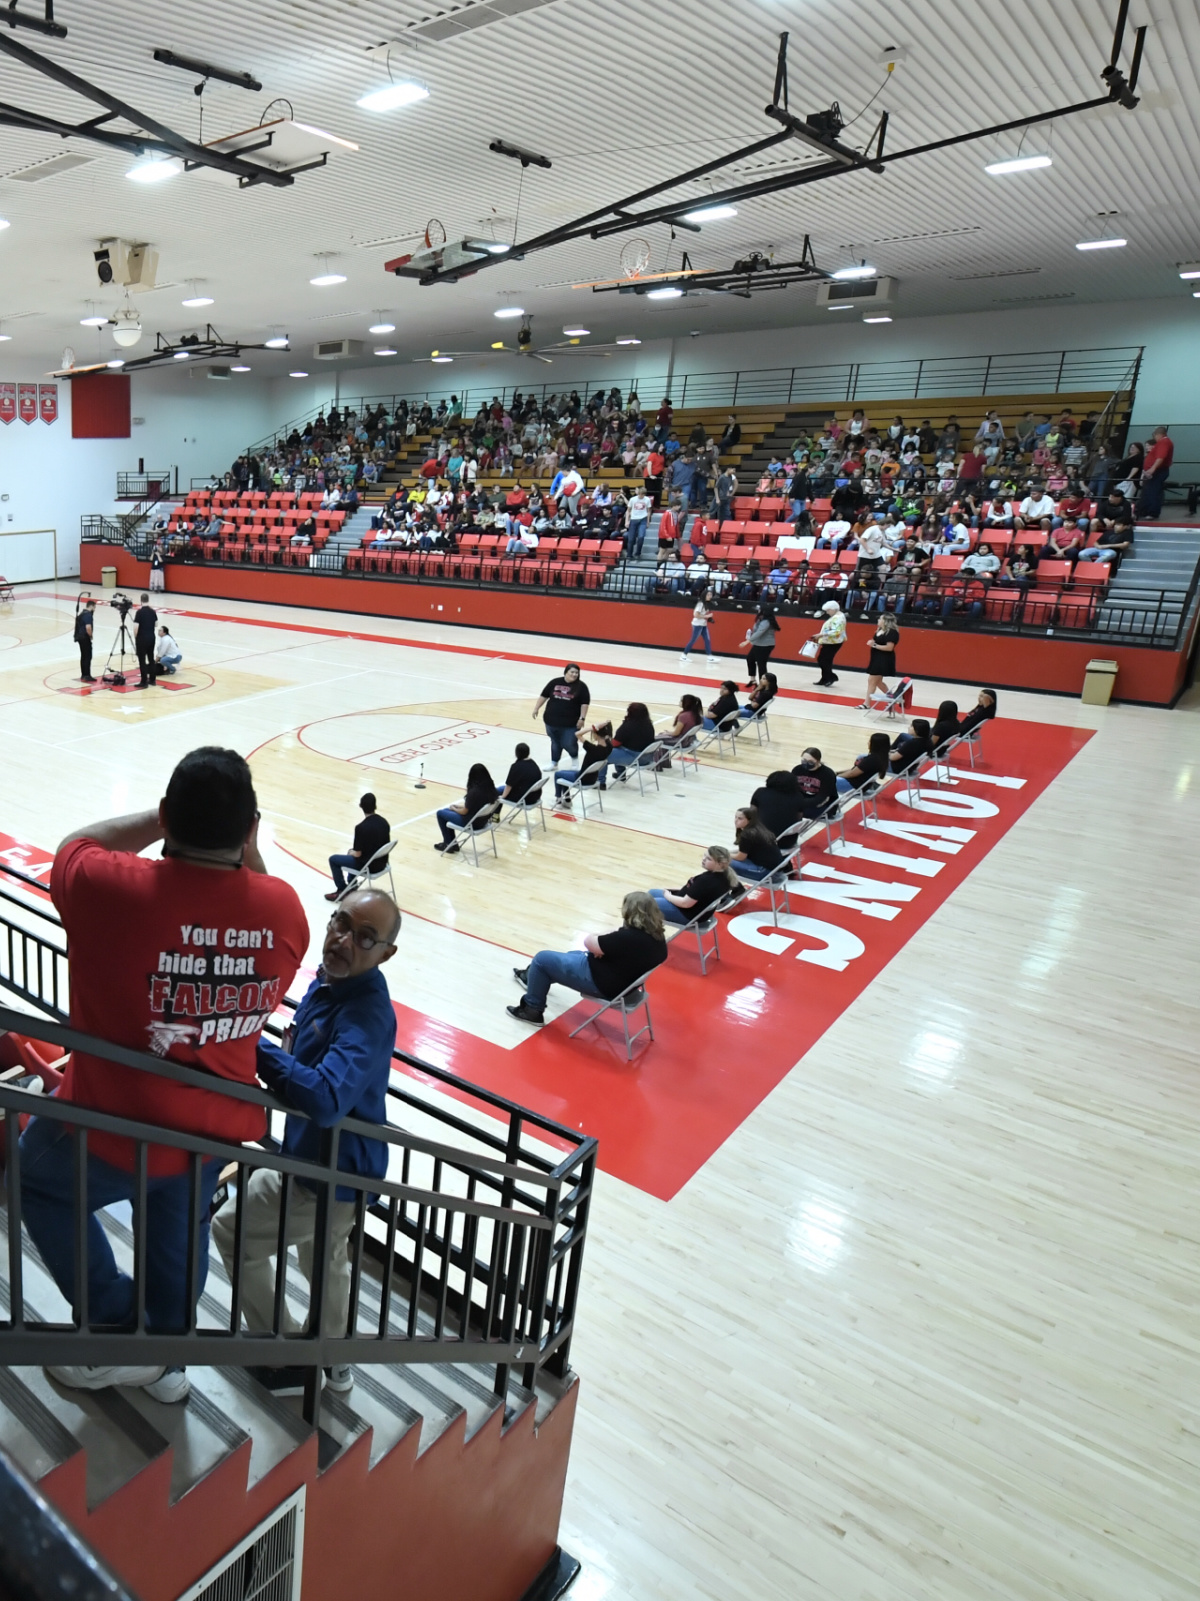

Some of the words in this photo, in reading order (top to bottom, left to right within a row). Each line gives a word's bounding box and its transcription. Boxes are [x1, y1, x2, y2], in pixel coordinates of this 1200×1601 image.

[420, 737, 463, 750] BIG
[454, 728, 490, 739] GO
[380, 748, 429, 763] RED
[727, 765, 1027, 972] LOVING
[180, 925, 218, 947] You
[158, 952, 206, 975] hide
[213, 954, 255, 976] that
[150, 974, 280, 1016] FALCON
